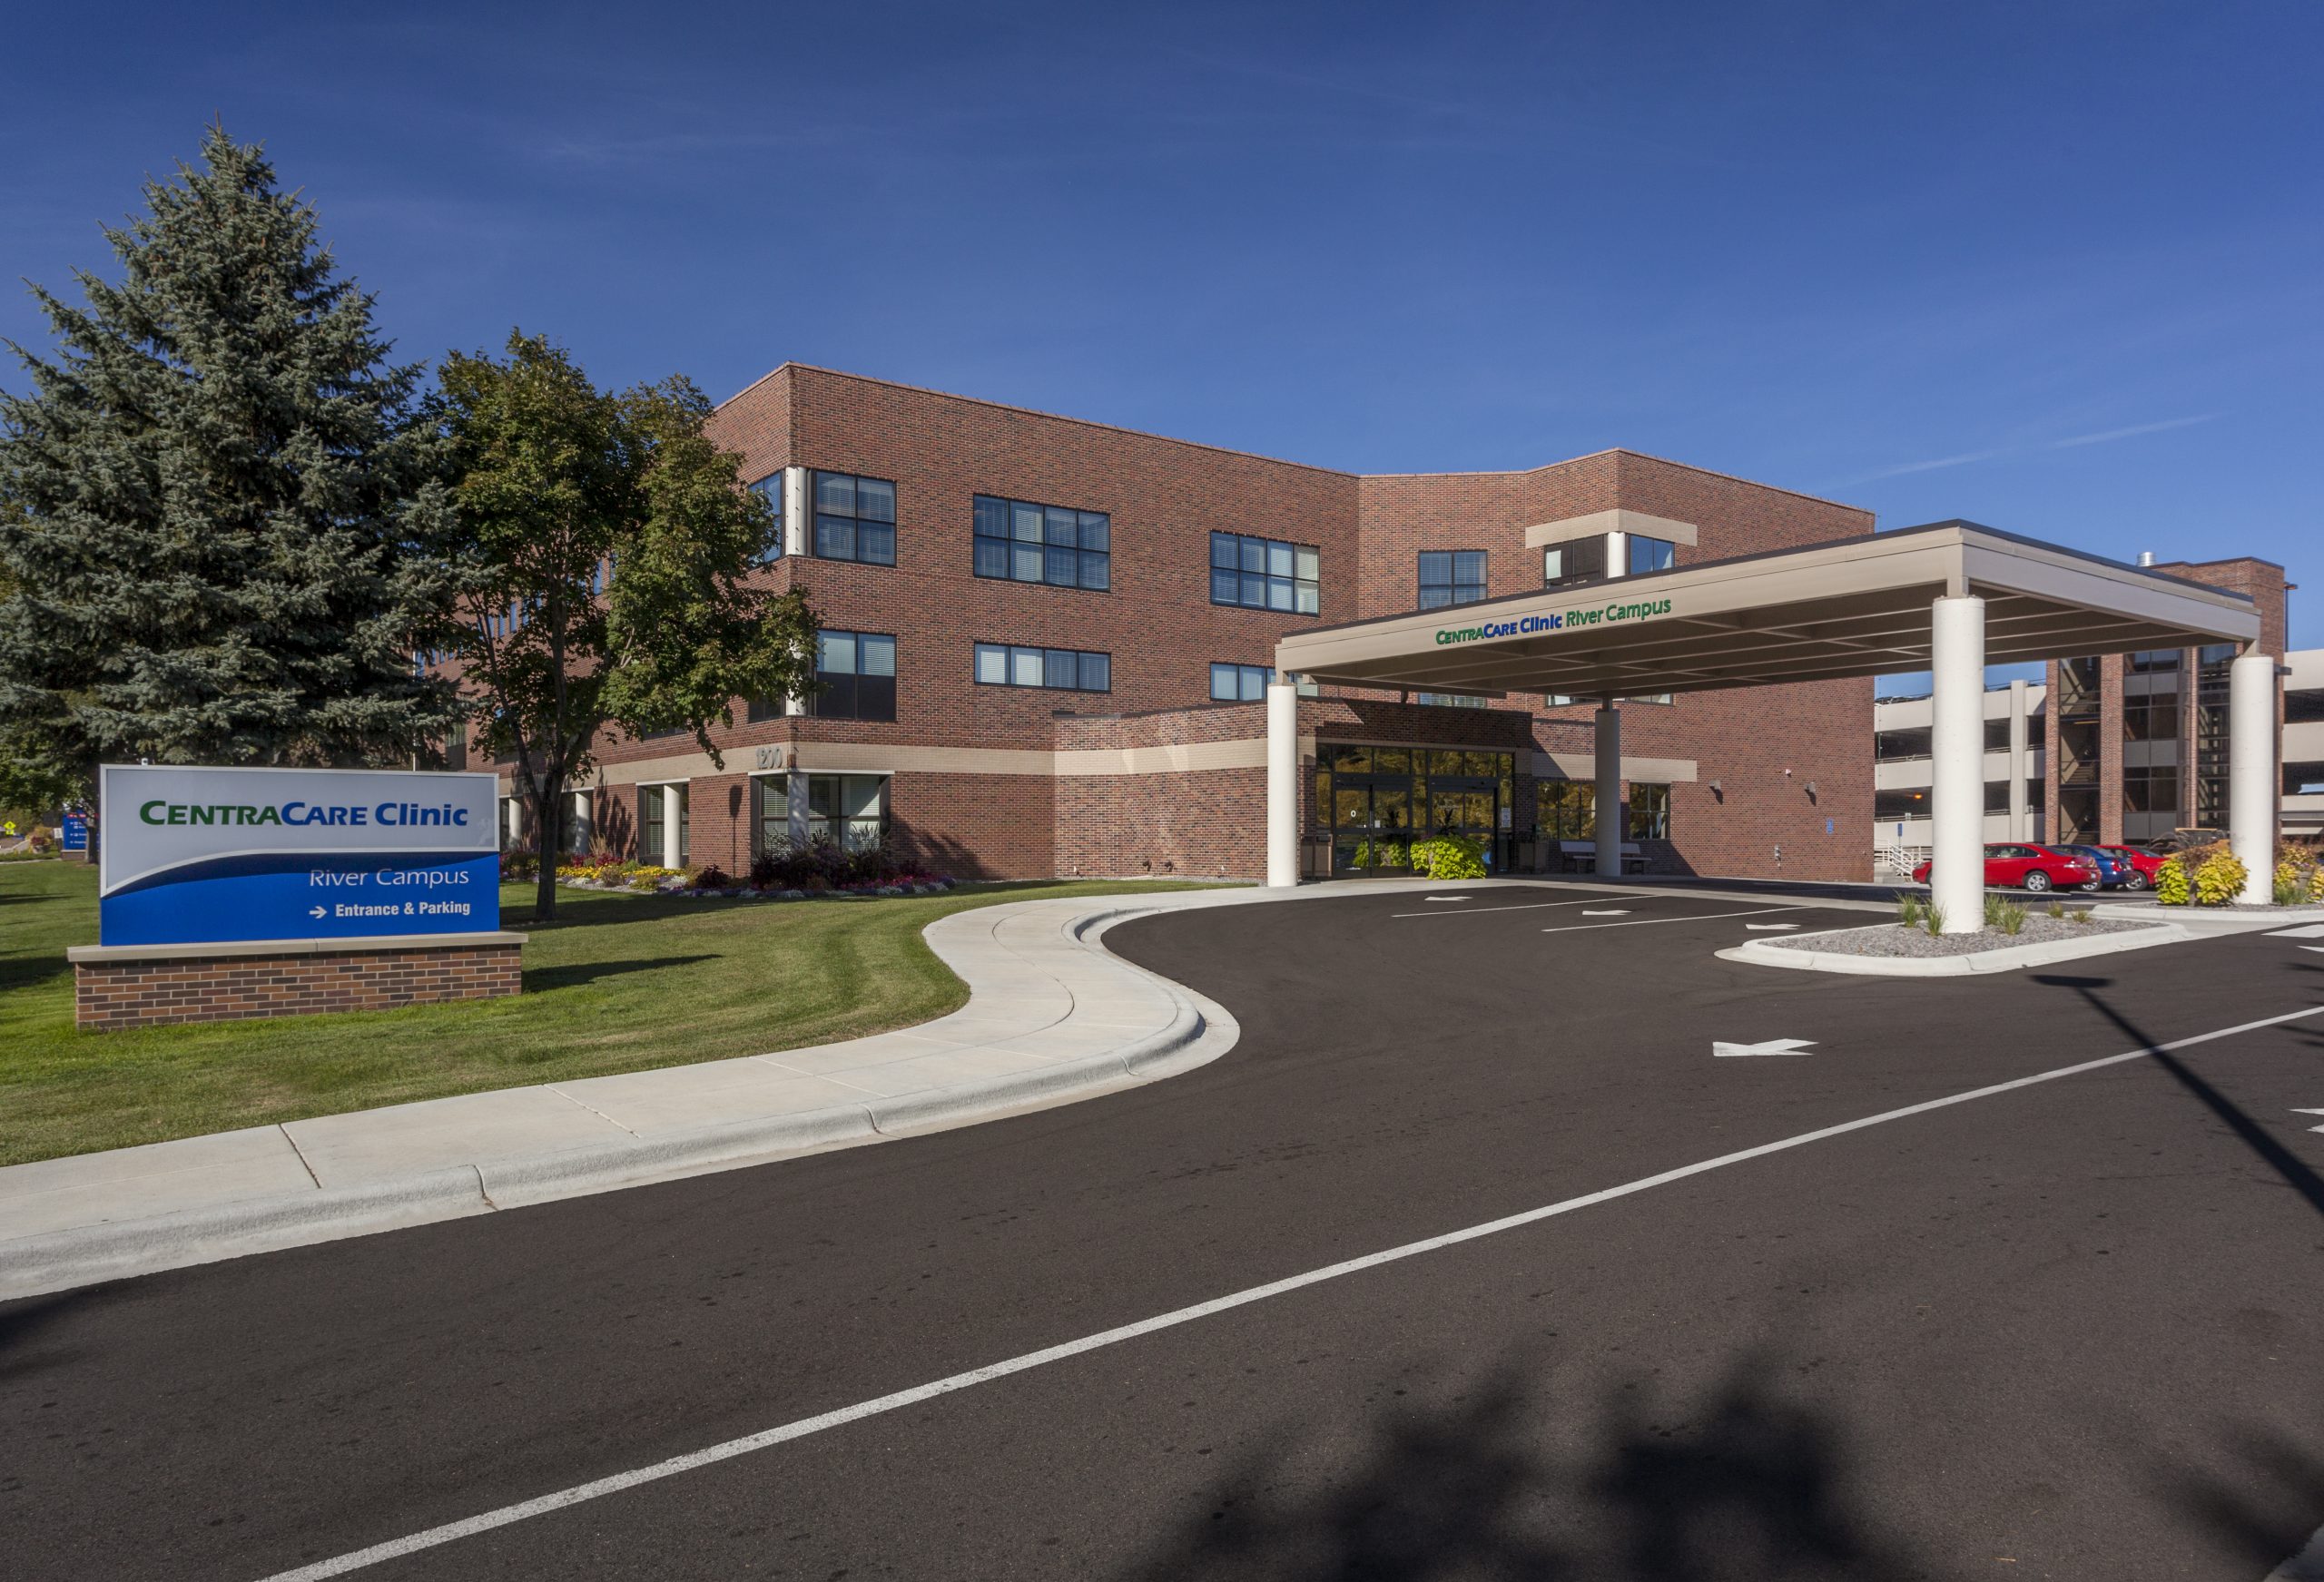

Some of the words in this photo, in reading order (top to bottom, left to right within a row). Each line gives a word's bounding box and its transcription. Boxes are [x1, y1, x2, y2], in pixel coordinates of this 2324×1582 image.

[1520, 615, 1562, 634] Clinic
[1566, 609, 1604, 627] River
[1605, 599, 1671, 621] Campus
[755, 746, 783, 770] 1200
[140, 800, 368, 826] CENTRACARE
[375, 802, 468, 827] Clinic
[310, 869, 369, 887] River
[376, 869, 470, 889] Campus
[335, 903, 399, 917] Entrance
[403, 901, 415, 916] &
[419, 900, 470, 916] Parking
